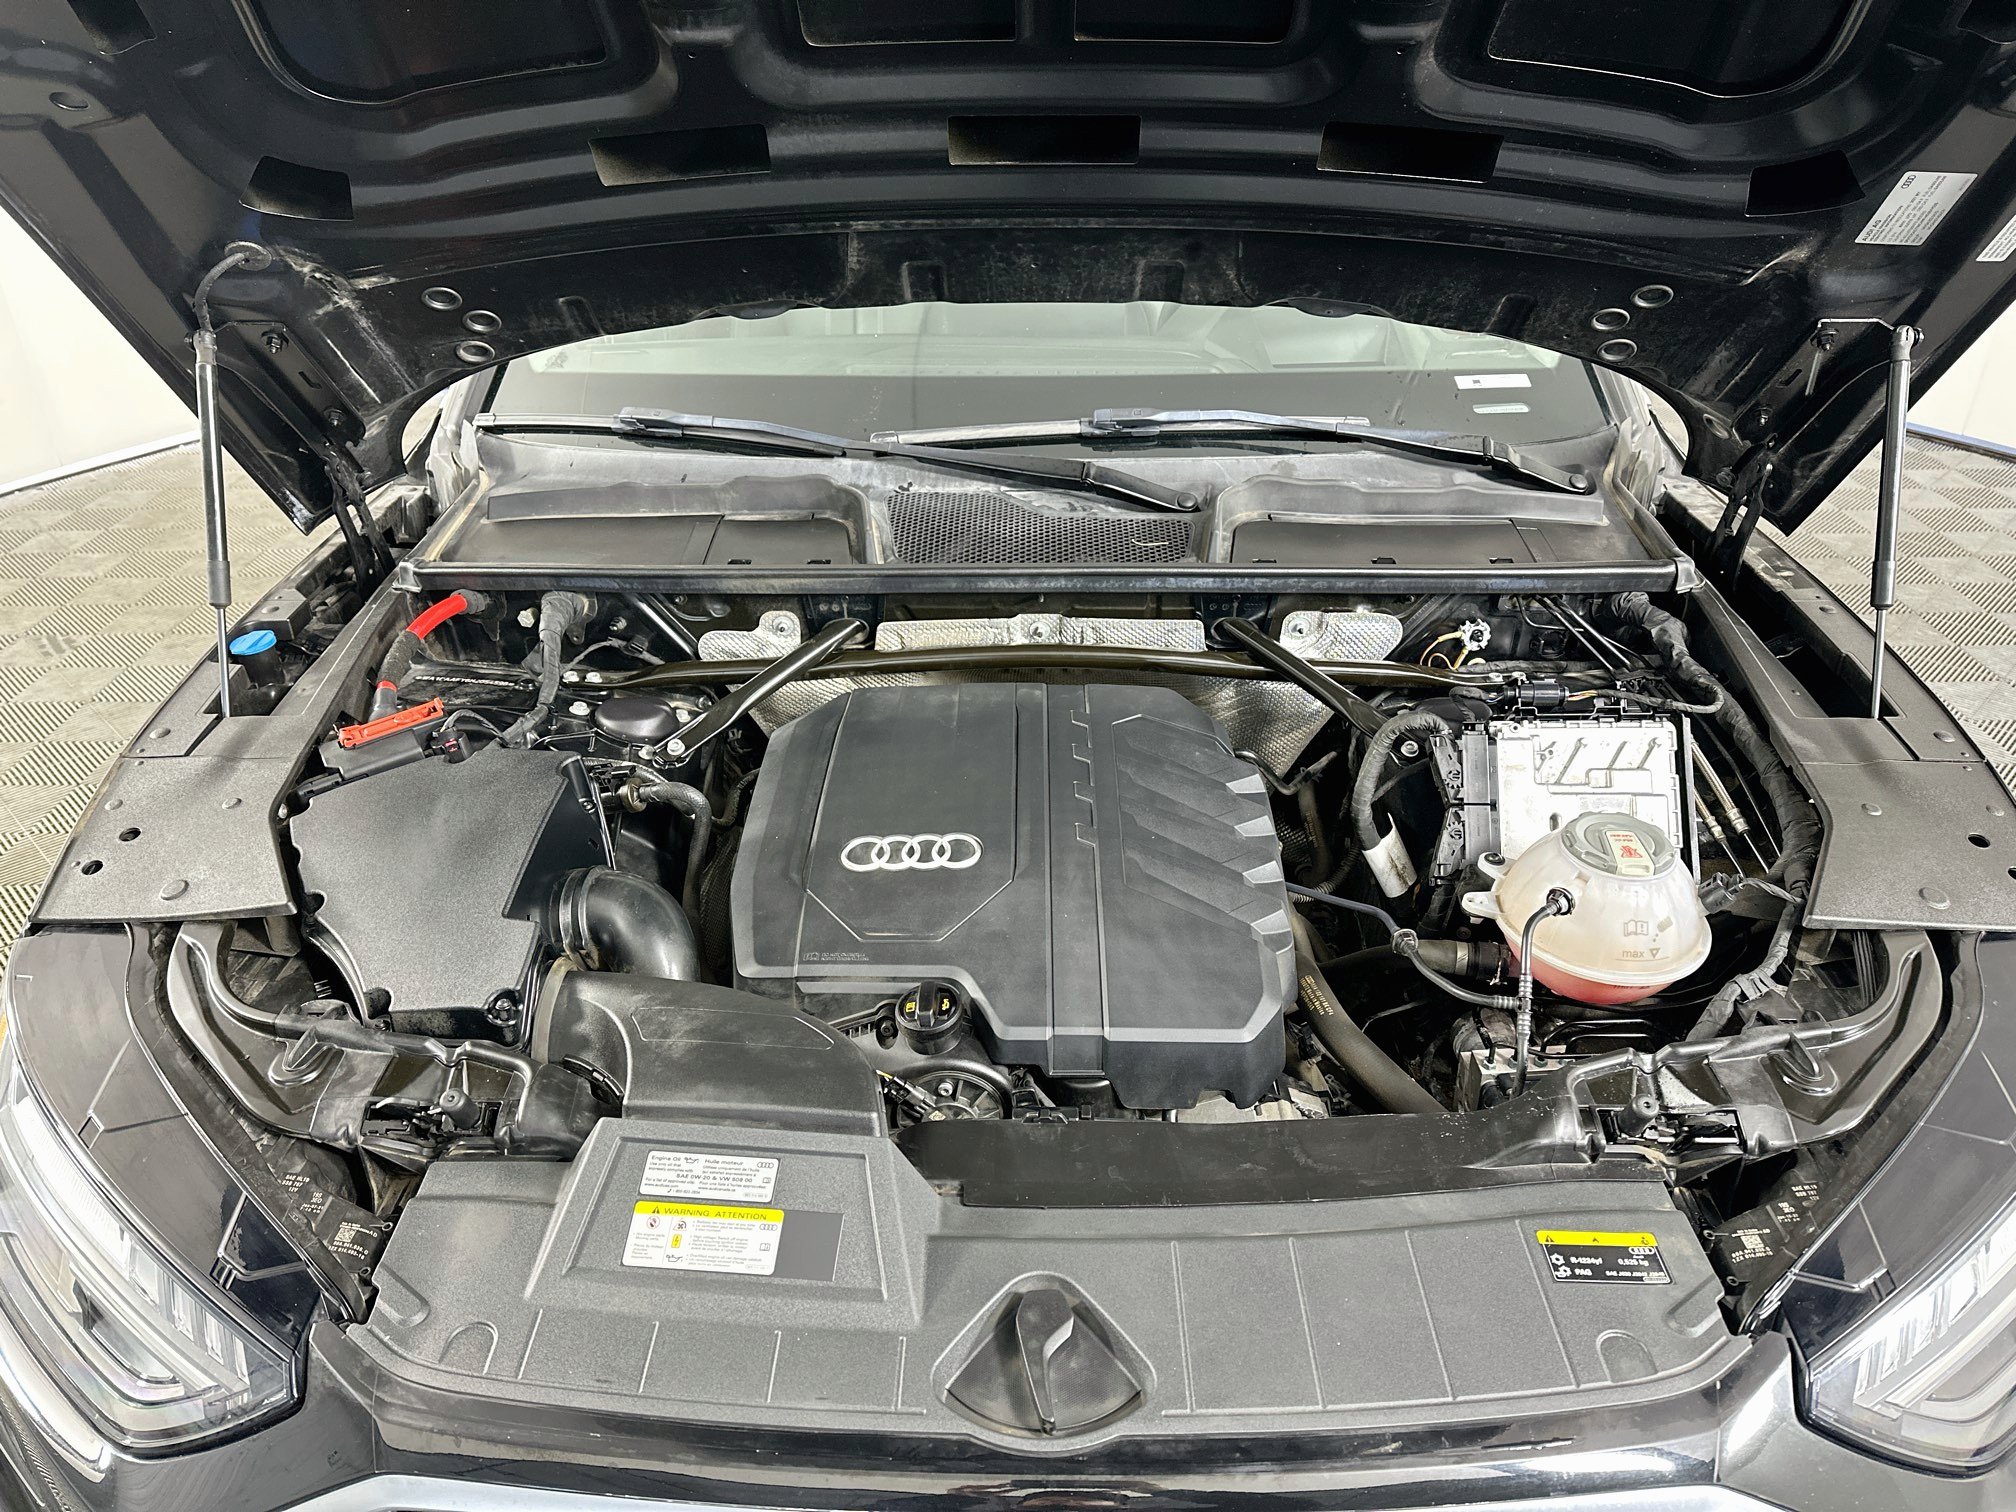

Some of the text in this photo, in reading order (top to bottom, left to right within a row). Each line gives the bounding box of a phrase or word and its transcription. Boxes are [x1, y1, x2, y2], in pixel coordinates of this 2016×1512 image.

[1622, 950, 1645, 959] max
[664, 1207, 767, 1220] WARNING ATTENTION
[1570, 1256, 1603, 1265] R-1234yf
[1574, 1268, 1593, 1276] PAG
